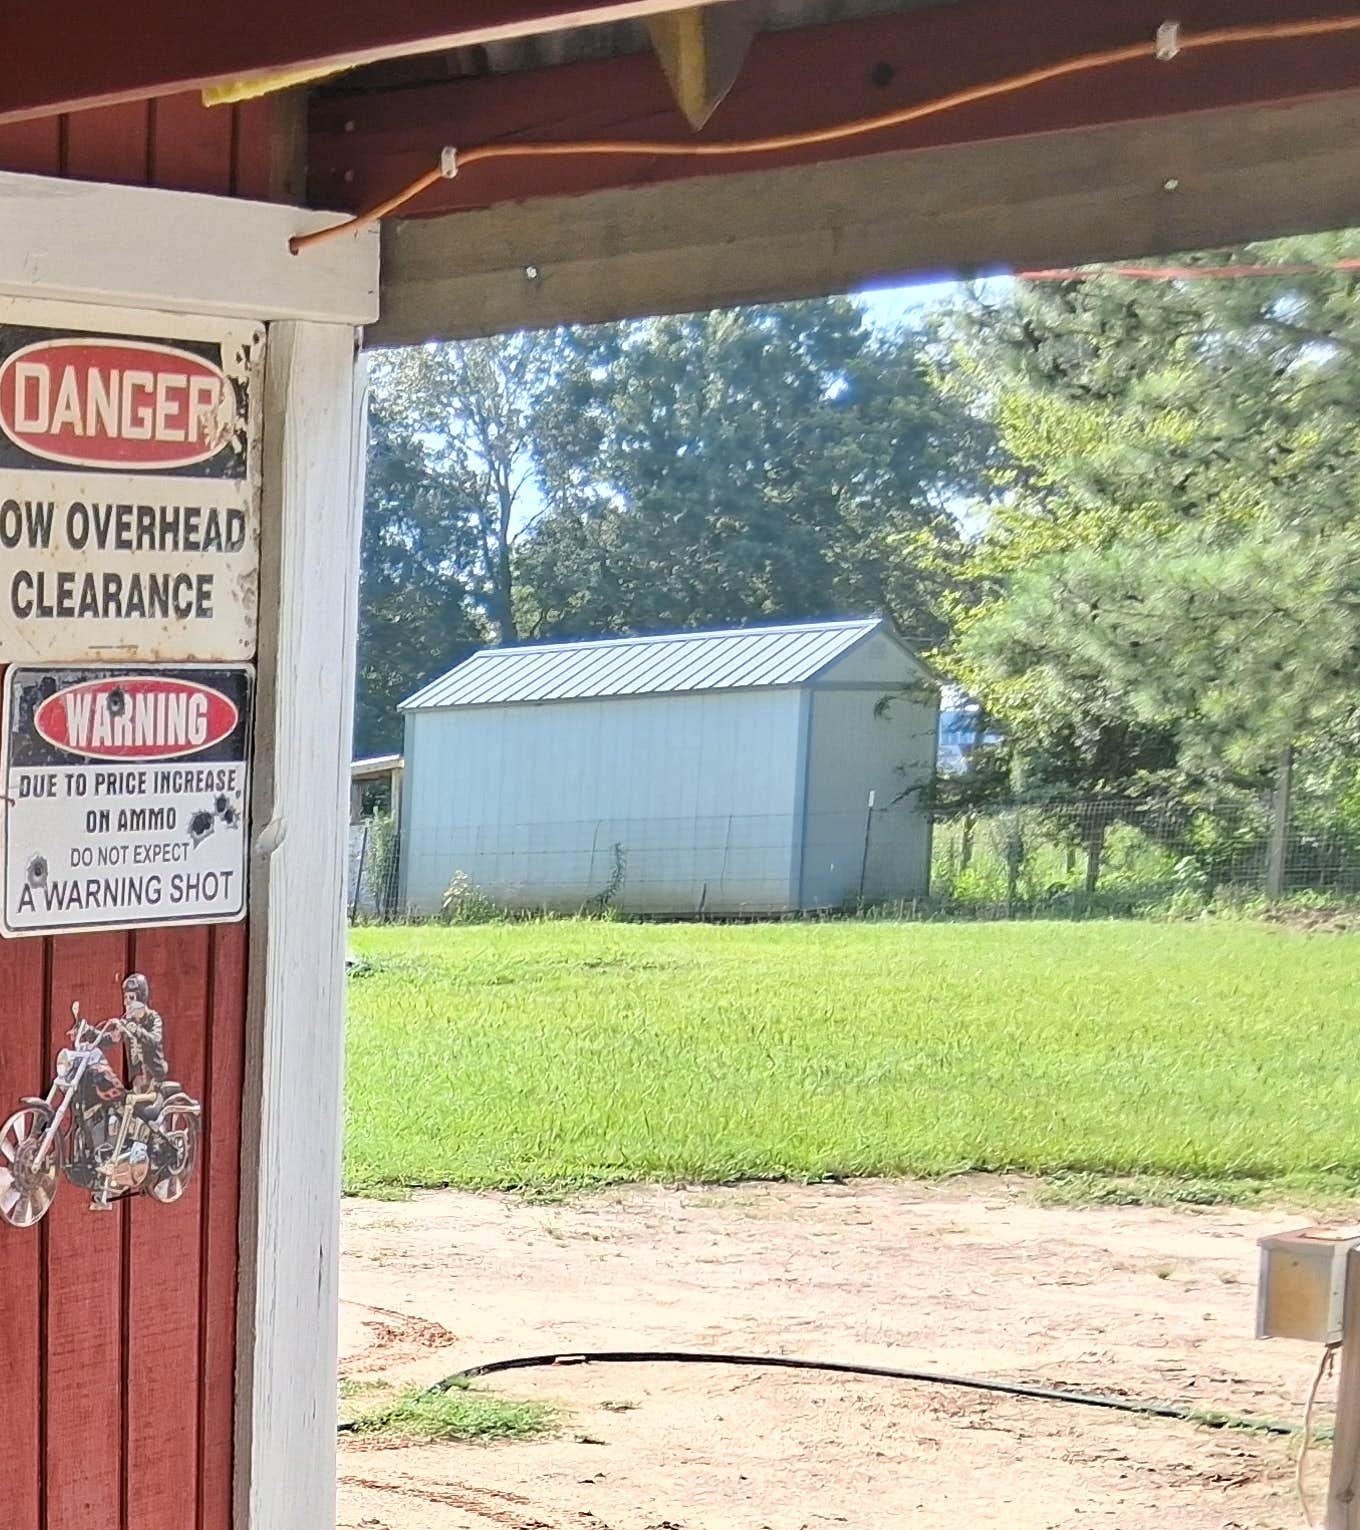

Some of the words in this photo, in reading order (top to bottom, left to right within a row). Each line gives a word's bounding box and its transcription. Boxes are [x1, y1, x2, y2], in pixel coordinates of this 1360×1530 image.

[15, 361, 227, 446] DANGER
[67, 502, 245, 553] OVERHEAD
[11, 571, 214, 620] CLEARANCE
[65, 692, 208, 748] WARNING
[19, 774, 59, 800] DUE
[66, 774, 88, 797] TO
[95, 772, 147, 796] PRICE
[86, 809, 112, 834] ON
[117, 806, 177, 833] AMMO
[70, 846, 95, 868] DO
[97, 845, 128, 867] NOT
[133, 842, 190, 865] EXPECT
[18, 882, 36, 913] A
[43, 876, 162, 912] WARNING
[170, 871, 233, 904] SHOT
